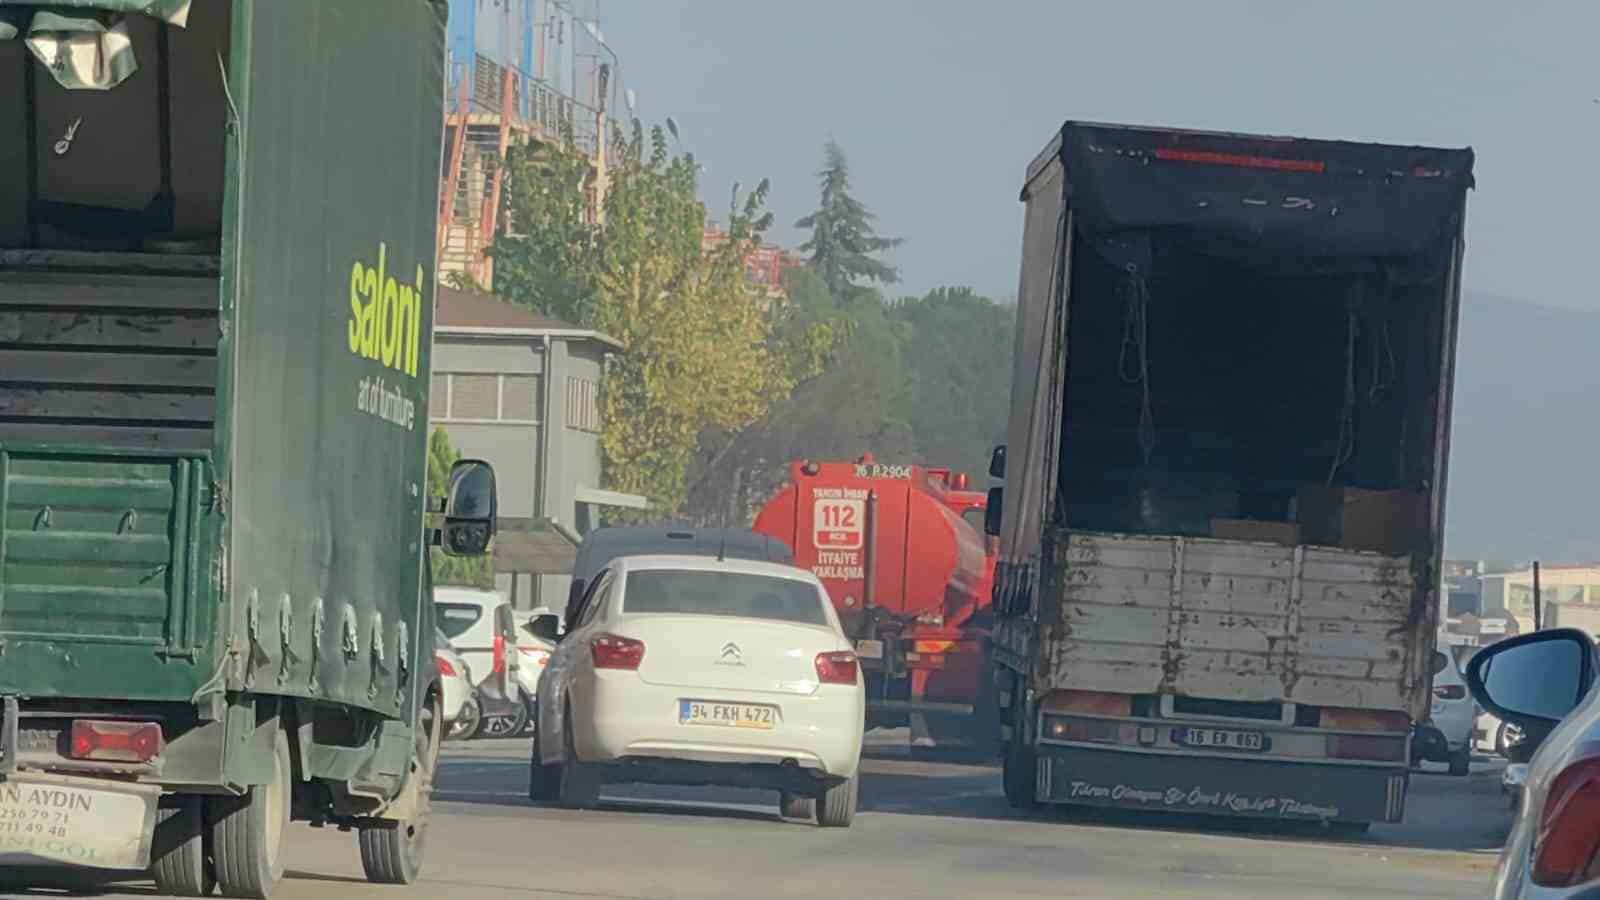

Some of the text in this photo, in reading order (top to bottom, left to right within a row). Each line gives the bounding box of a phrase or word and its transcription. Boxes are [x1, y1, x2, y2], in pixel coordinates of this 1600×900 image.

[349, 241, 424, 378] saloni
[822, 505, 856, 528] 112
[692, 704, 771, 723] 34 FKH 472
[55, 812, 69, 824] 71
[25, 823, 43, 833] 49
